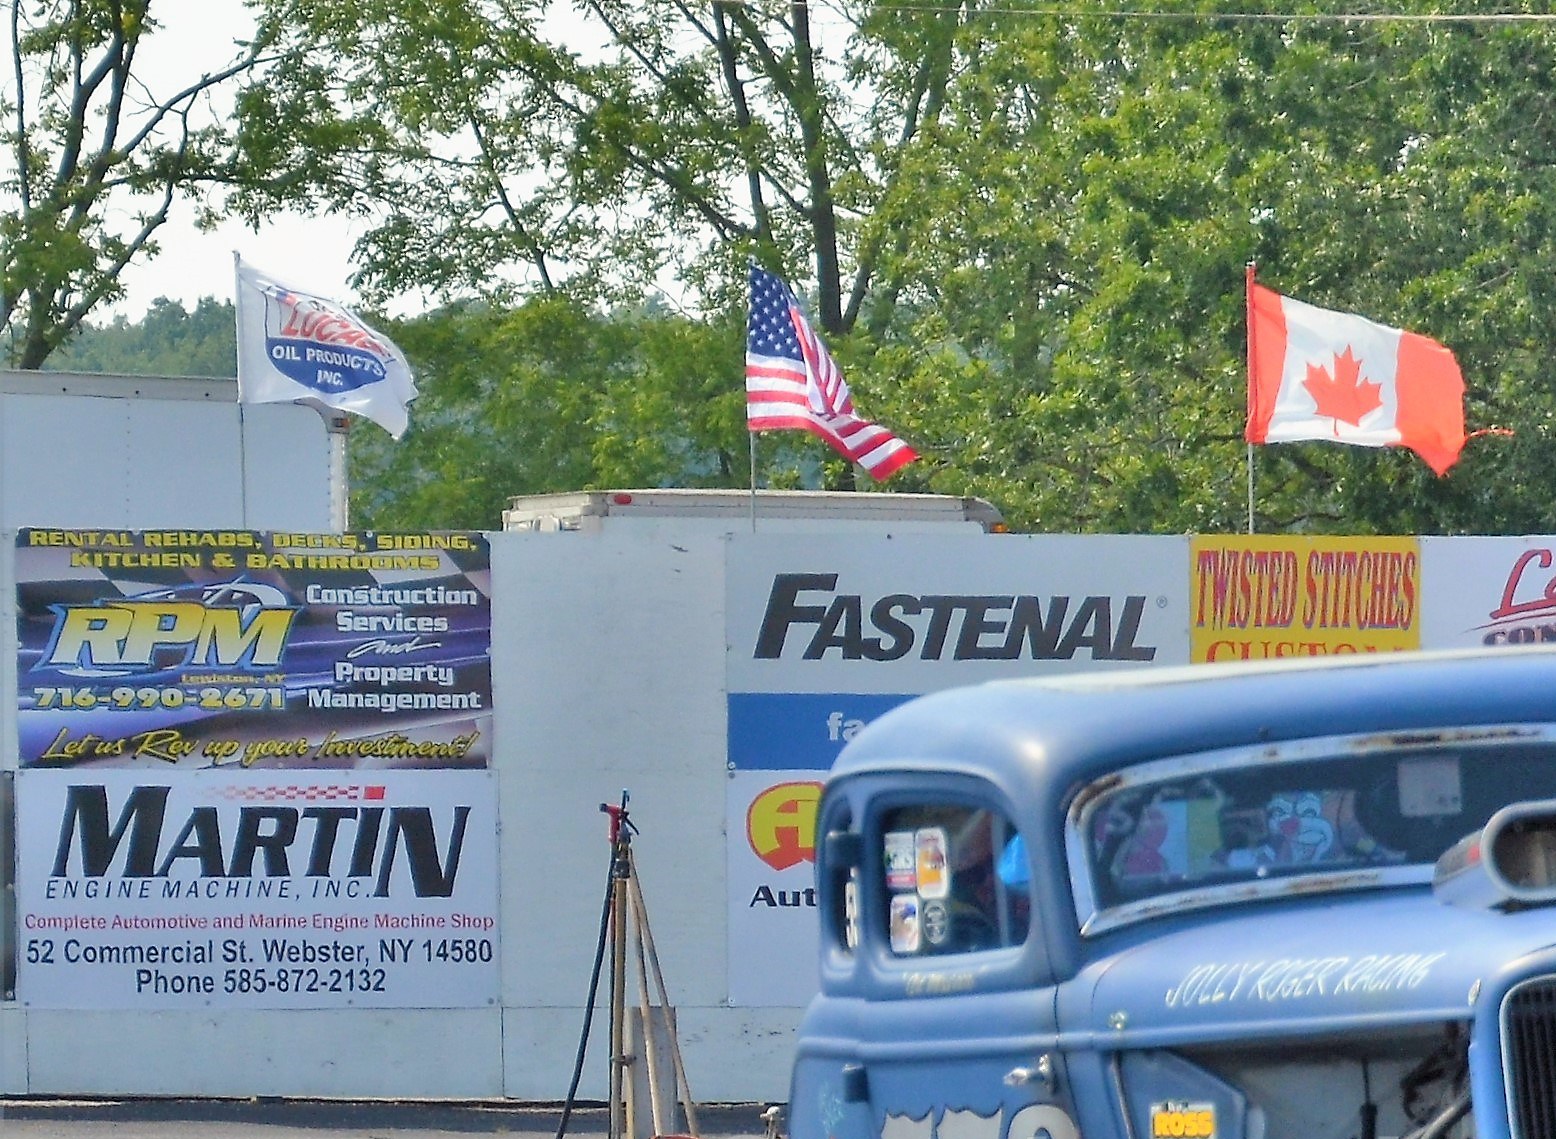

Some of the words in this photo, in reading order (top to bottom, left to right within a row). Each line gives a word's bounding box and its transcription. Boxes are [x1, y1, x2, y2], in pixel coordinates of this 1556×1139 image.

[272, 345, 300, 360] OIL
[306, 347, 383, 376] PRODUCTS
[317, 369, 344, 385] INC.
[29, 531, 133, 548] RENTAL
[144, 531, 262, 550] REHABS,
[272, 532, 366, 551] DECKS,
[377, 533, 477, 552] SIDING,
[70, 552, 200, 569] KITCHEN
[212, 552, 235, 568] &
[246, 553, 440, 570] BATHROOMS
[306, 584, 478, 606] Construction
[1196, 548, 1298, 631] TWISTED
[1303, 549, 1416, 631] STITCHES
[335, 610, 449, 633] Services
[753, 572, 1157, 661] FASTENAL
[49, 603, 298, 666] RPM
[335, 662, 455, 687] Property
[33, 686, 285, 710] 716-990-2671
[307, 688, 482, 713] Management
[41, 726, 98, 761] Let
[96, 737, 128, 757] us
[131, 728, 200, 763] Rev
[201, 739, 240, 767] up
[241, 739, 309, 768] your
[49, 785, 472, 898] MARTIN
[45, 880, 152, 899] ENGINE
[161, 880, 301, 902] MACHINE,
[311, 880, 375, 899] INC.
[25, 913, 107, 932] Complete
[111, 913, 208, 930] Automotive
[213, 913, 246, 930] and
[249, 913, 307, 930] Marine
[312, 913, 369, 933] Engine
[373, 913, 447, 930] Machine
[451, 913, 495, 932] Shop
[26, 940, 55, 965] 52
[63, 939, 214, 965] Commercial
[221, 940, 254, 965] St.
[262, 940, 370, 969] Webster,
[379, 940, 415, 965] NY
[422, 940, 493, 965] 14580
[136, 969, 215, 994] Phone
[223, 969, 386, 995] 585-872-2132
[1153, 1111, 1213, 1139] ROSS
